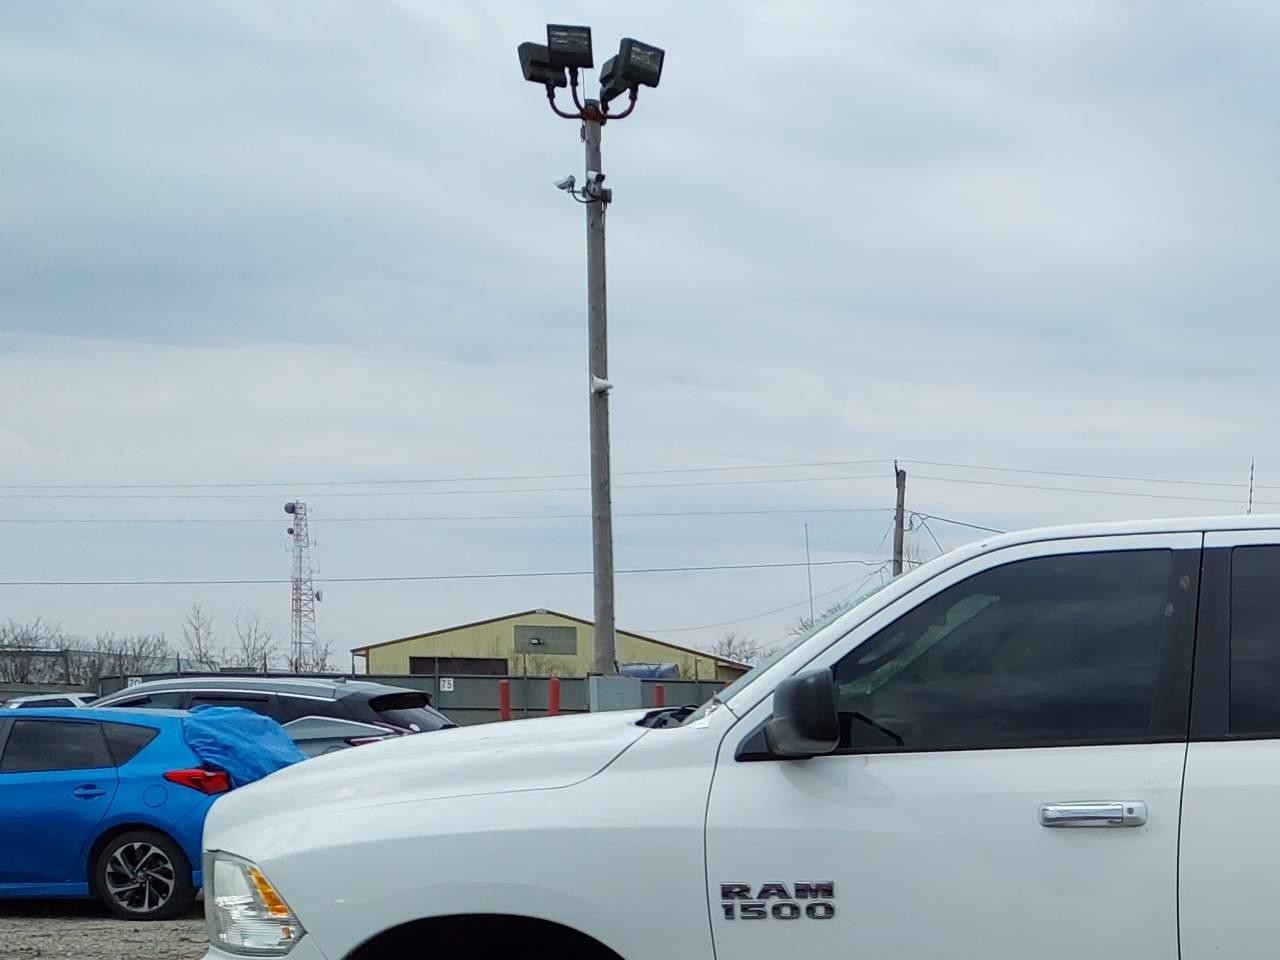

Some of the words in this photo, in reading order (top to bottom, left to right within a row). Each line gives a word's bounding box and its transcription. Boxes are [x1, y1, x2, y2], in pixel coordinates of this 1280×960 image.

[441, 679, 452, 689] 75
[720, 880, 835, 899] RAM
[721, 901, 836, 920] 1500
